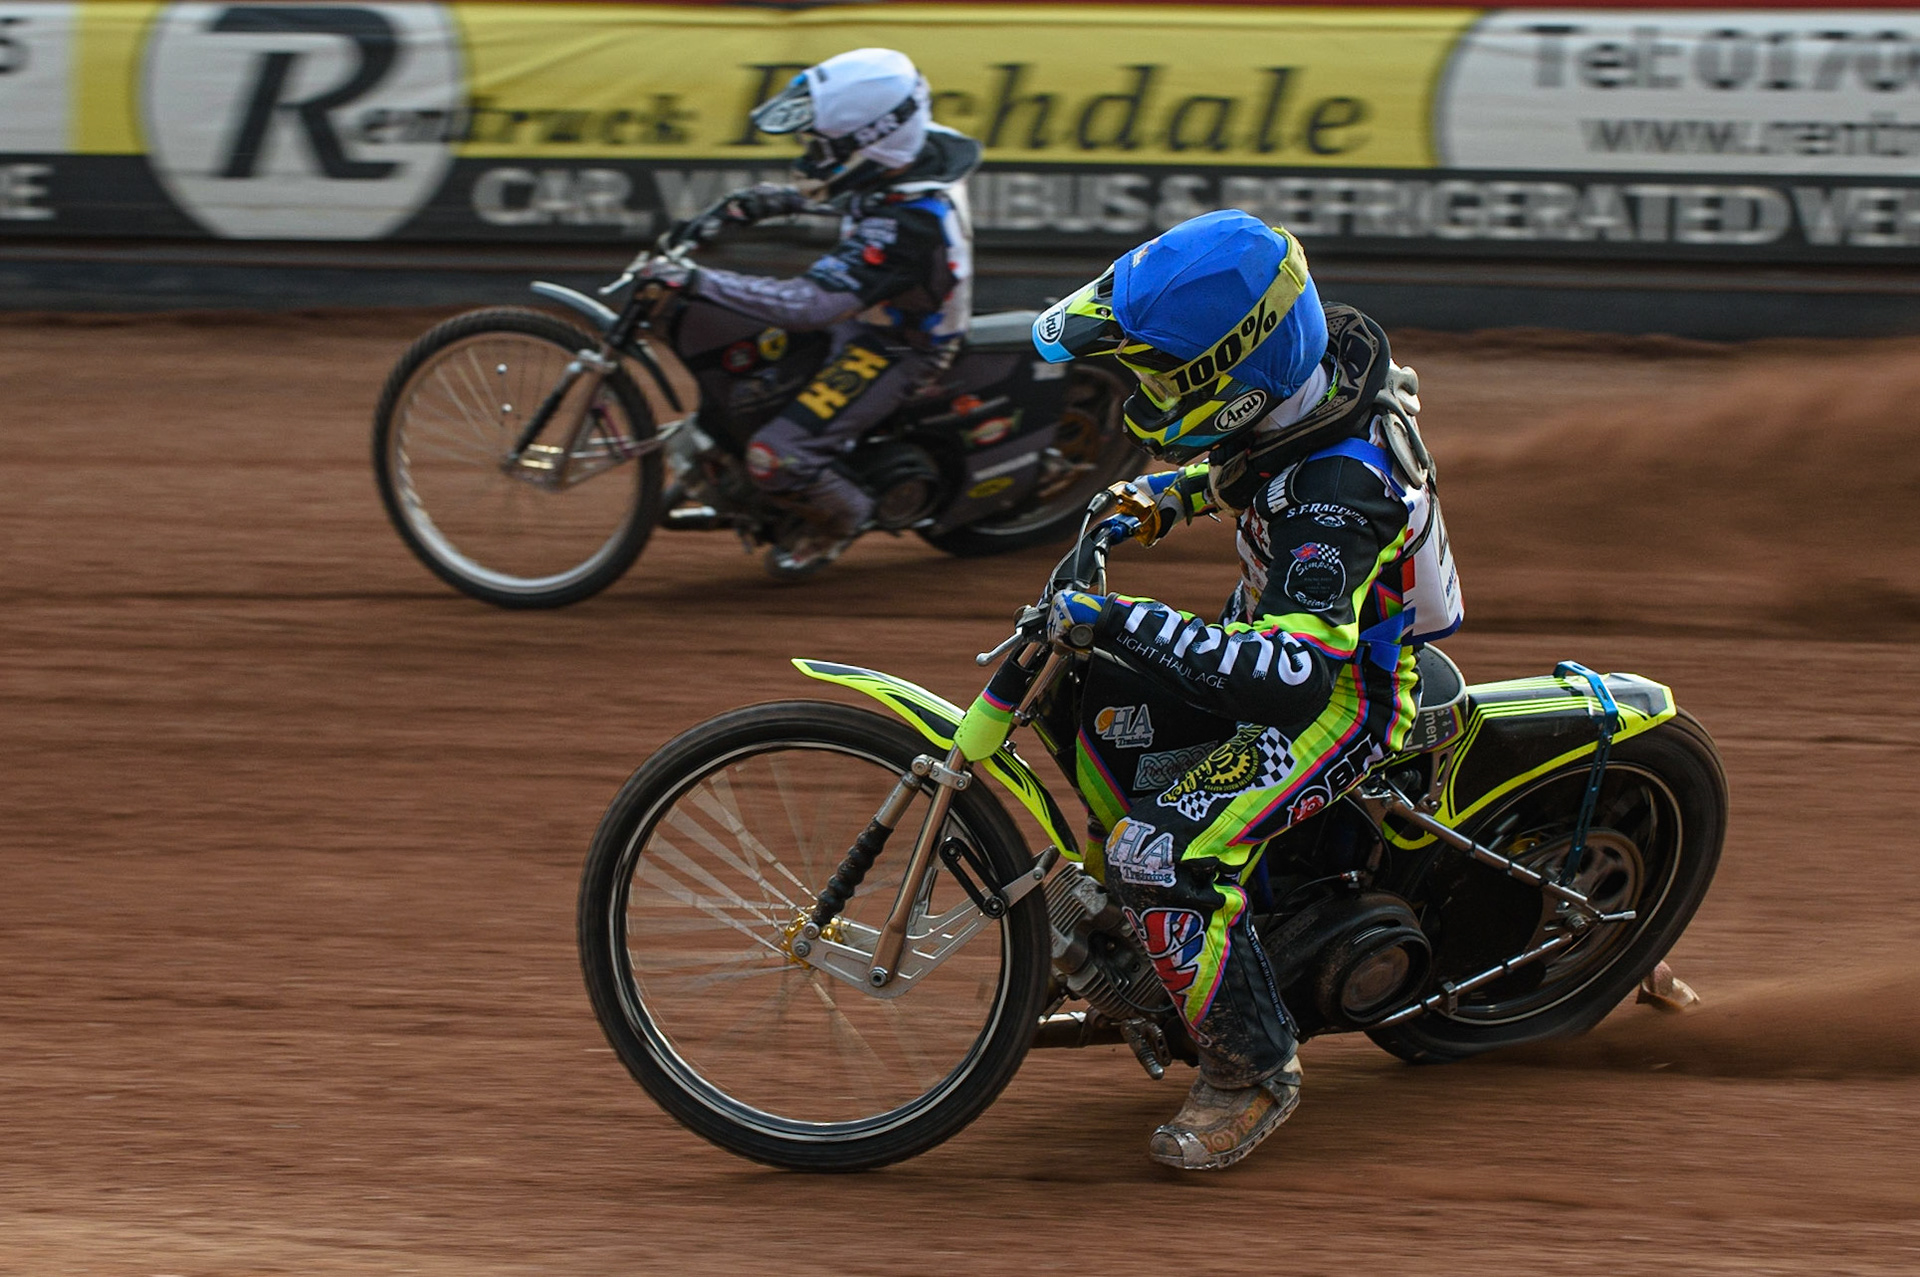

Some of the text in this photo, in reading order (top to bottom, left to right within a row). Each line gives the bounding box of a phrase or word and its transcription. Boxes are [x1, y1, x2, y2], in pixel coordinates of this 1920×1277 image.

[735, 62, 1370, 156] chdale
[1170, 297, 1278, 394] 100%
[1116, 631, 1229, 690] LIGHT HAULAGE
